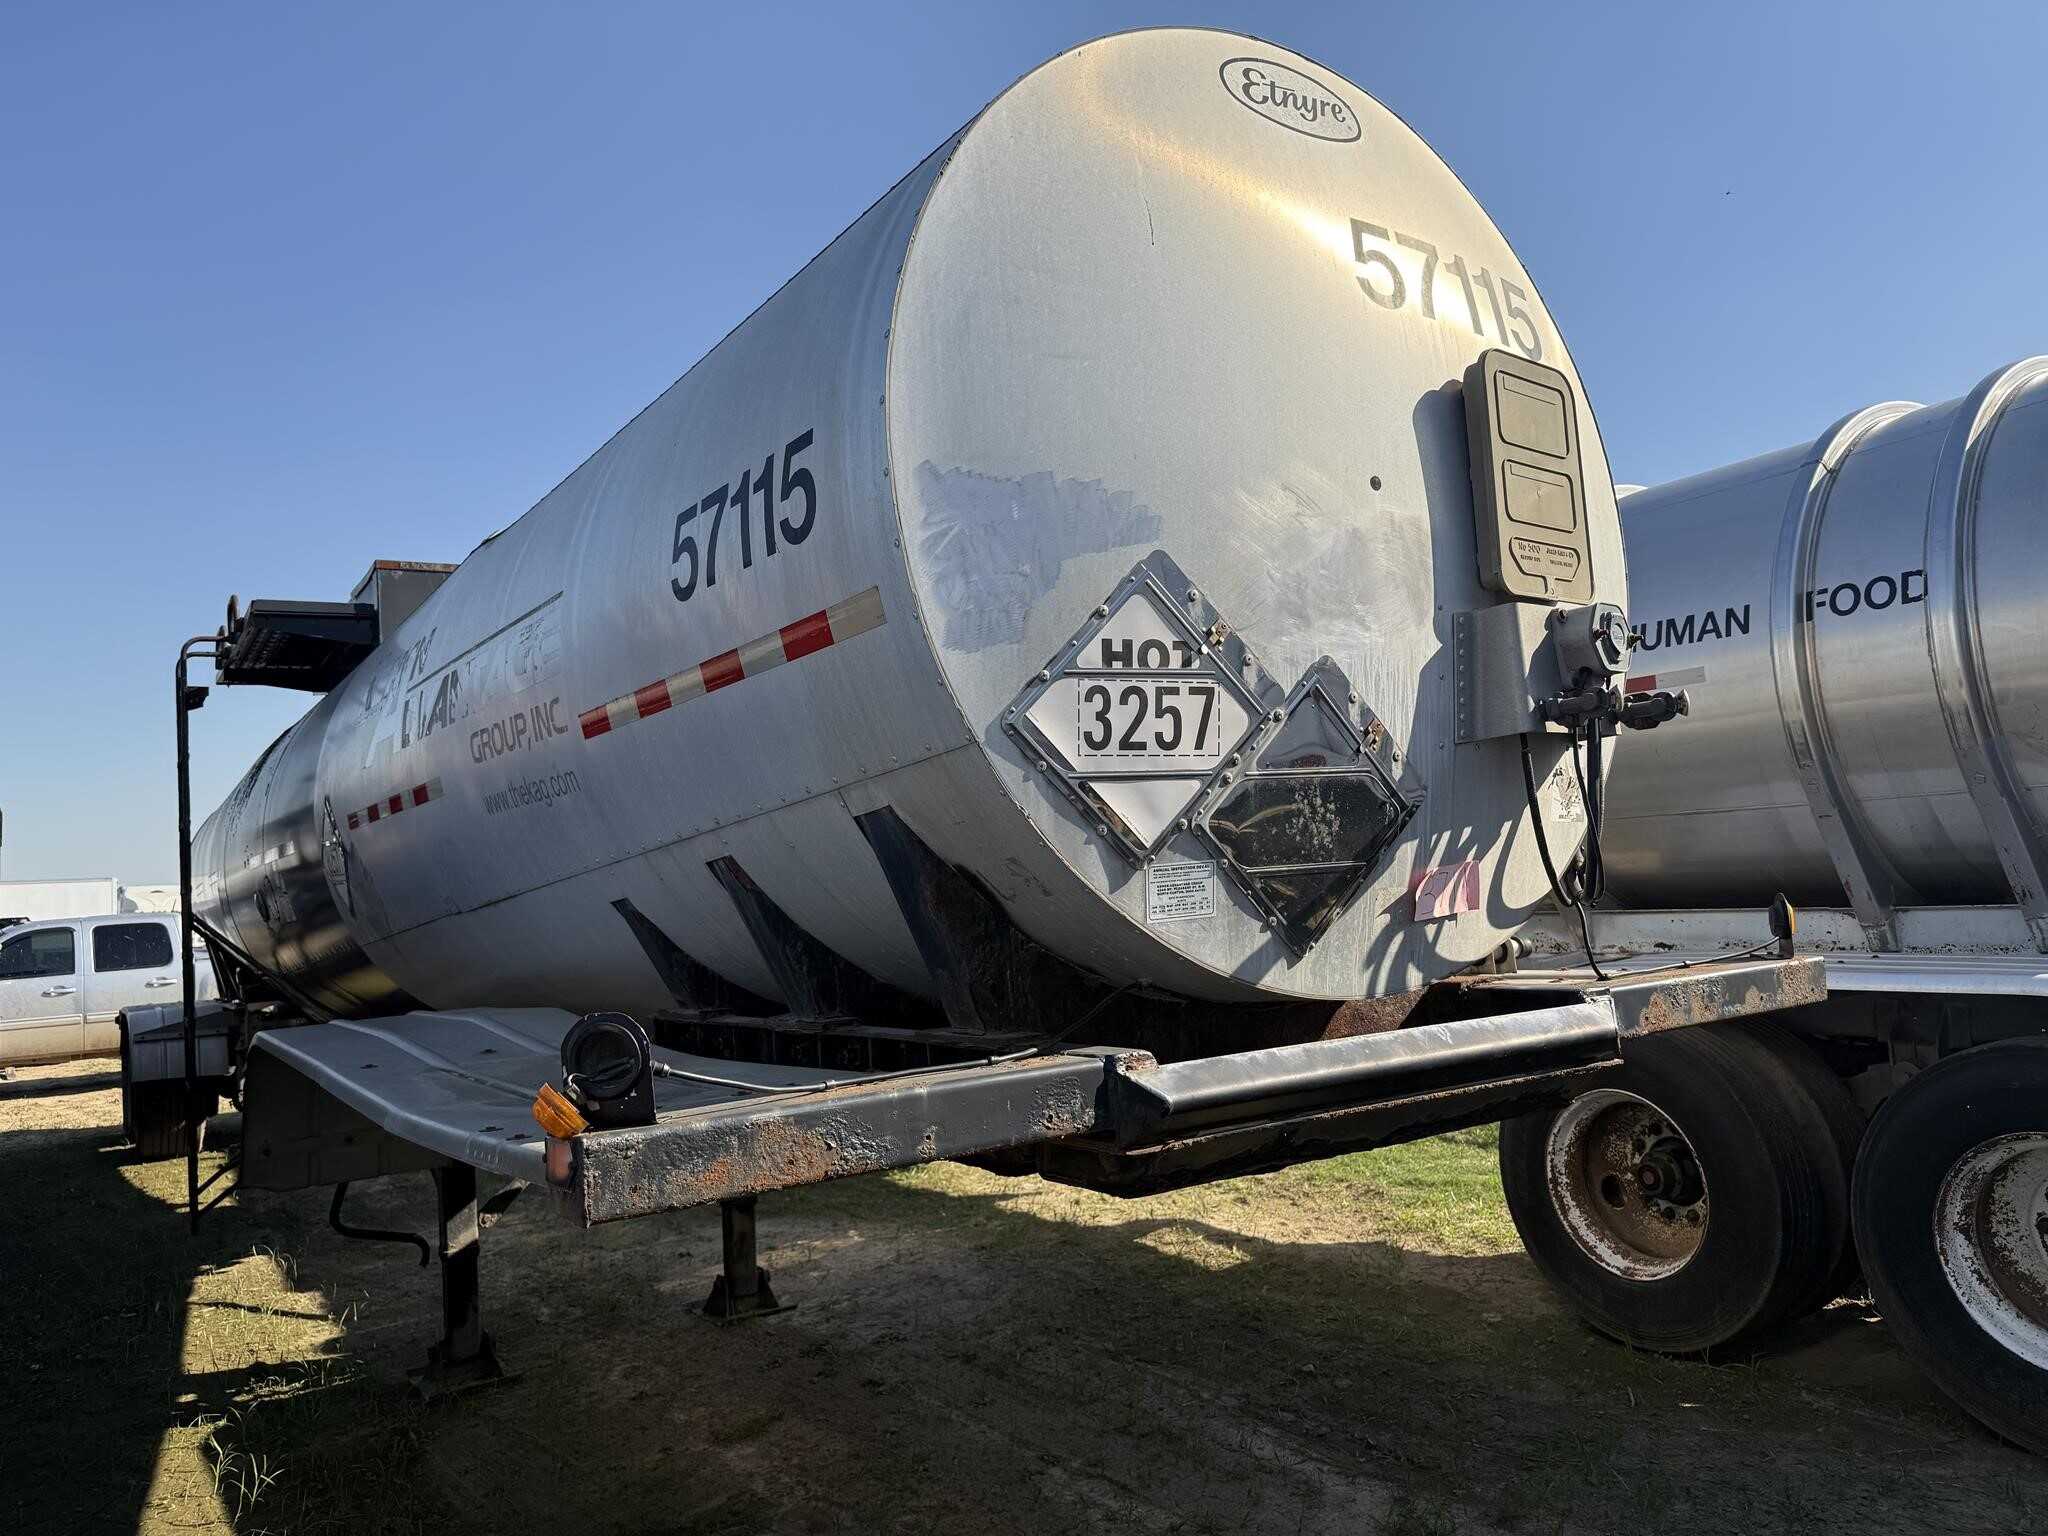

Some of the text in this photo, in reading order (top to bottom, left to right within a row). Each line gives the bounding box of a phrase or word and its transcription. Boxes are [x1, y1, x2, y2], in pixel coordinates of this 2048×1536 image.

[1241, 67, 1346, 122] Etnyre
[1349, 217, 1542, 361] 57115
[671, 428, 817, 602] 57115
[1804, 569, 1929, 622] FOOD
[1101, 638, 1194, 669] HOT
[1083, 684, 1215, 752] 3257
[484, 770, 582, 816] www.thekag.com
